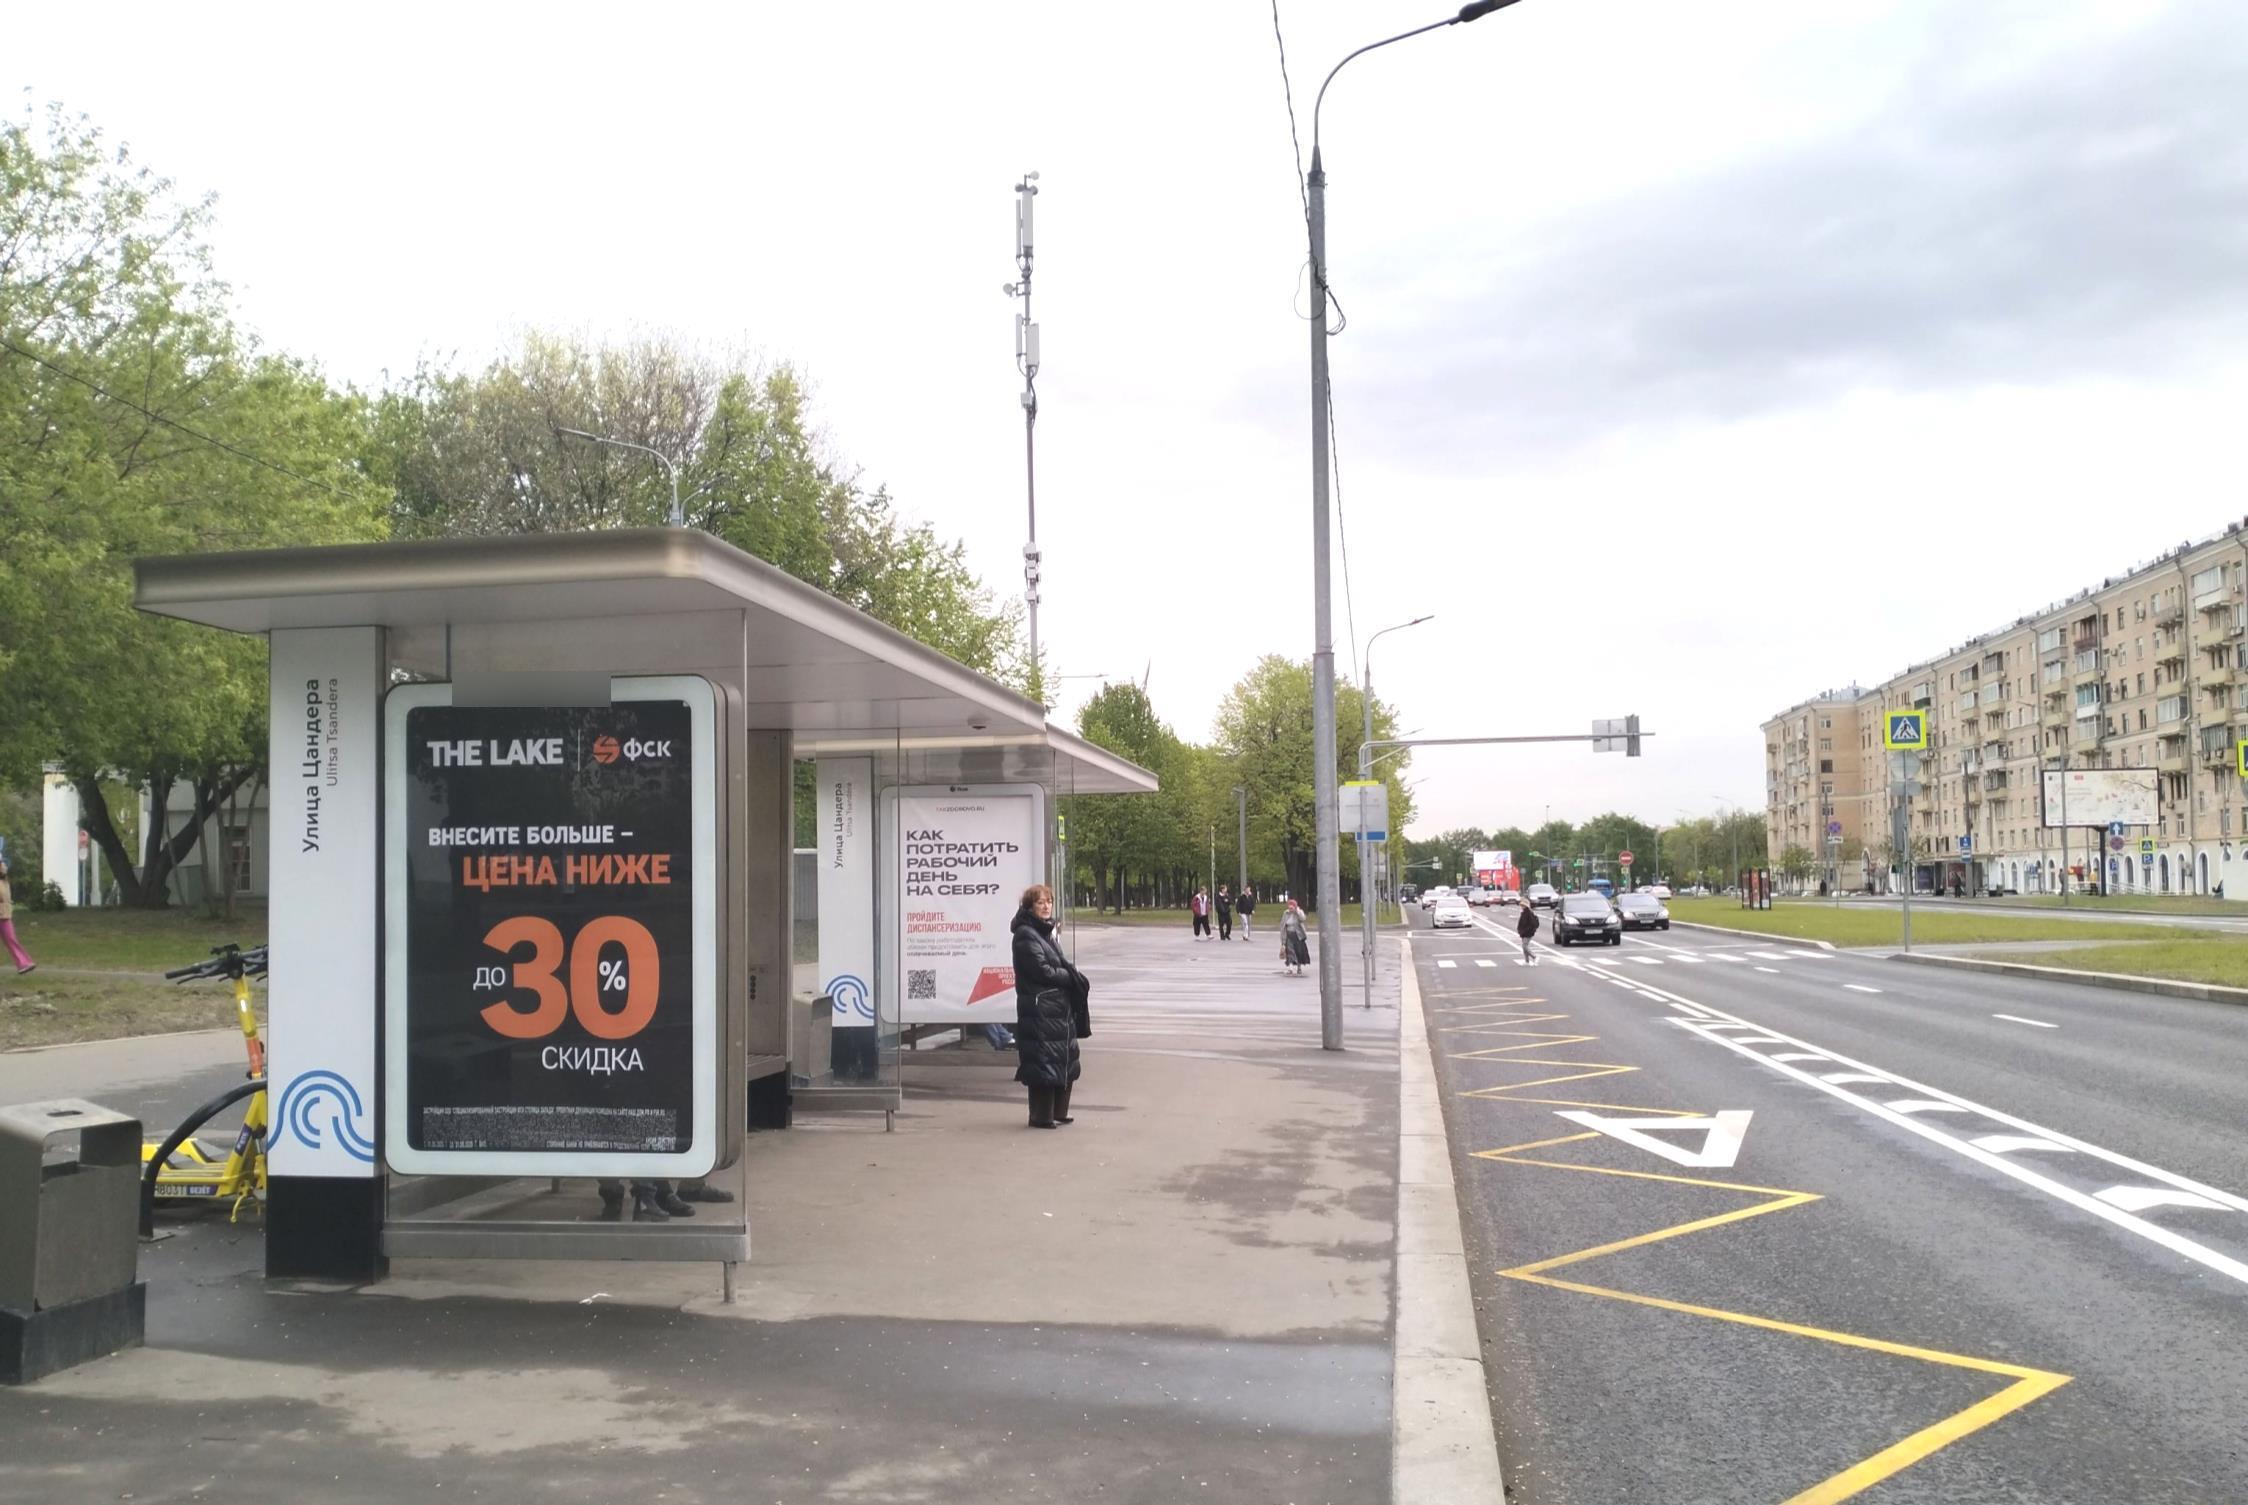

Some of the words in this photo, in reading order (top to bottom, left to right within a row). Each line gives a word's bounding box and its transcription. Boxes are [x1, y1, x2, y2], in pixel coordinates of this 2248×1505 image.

[326, 678, 338, 743] Tsandera
[303, 679, 323, 777] Цандера
[326, 747, 338, 787] Ulitsa
[427, 740, 482, 767] THE
[490, 738, 564, 766] LAKE
[303, 785, 321, 852] Улица
[834, 783, 844, 832] Цандера
[428, 827, 520, 846] ВНЕСИТЕ
[526, 825, 614, 844] БОЛЬШЕ
[906, 830, 943, 841] КАК
[906, 842, 1019, 855] ПОТРАТИТЬ
[834, 835, 844, 869] Улица
[906, 854, 998, 868] РАБОЧИЙ
[463, 855, 557, 893] ЦЕНА
[566, 854, 671, 884] НИЖЕ
[906, 871, 958, 883] ДЕНЬ
[906, 885, 933, 896] НА
[937, 884, 999, 896] СЕБЯ?
[907, 910, 945, 922] ПРОЙДИТЕ
[907, 922, 982, 933] ДИСПАНСЕРИЗАЦИЮ
[480, 915, 660, 1040] 30
[541, 1046, 644, 1076] СКИДКА
